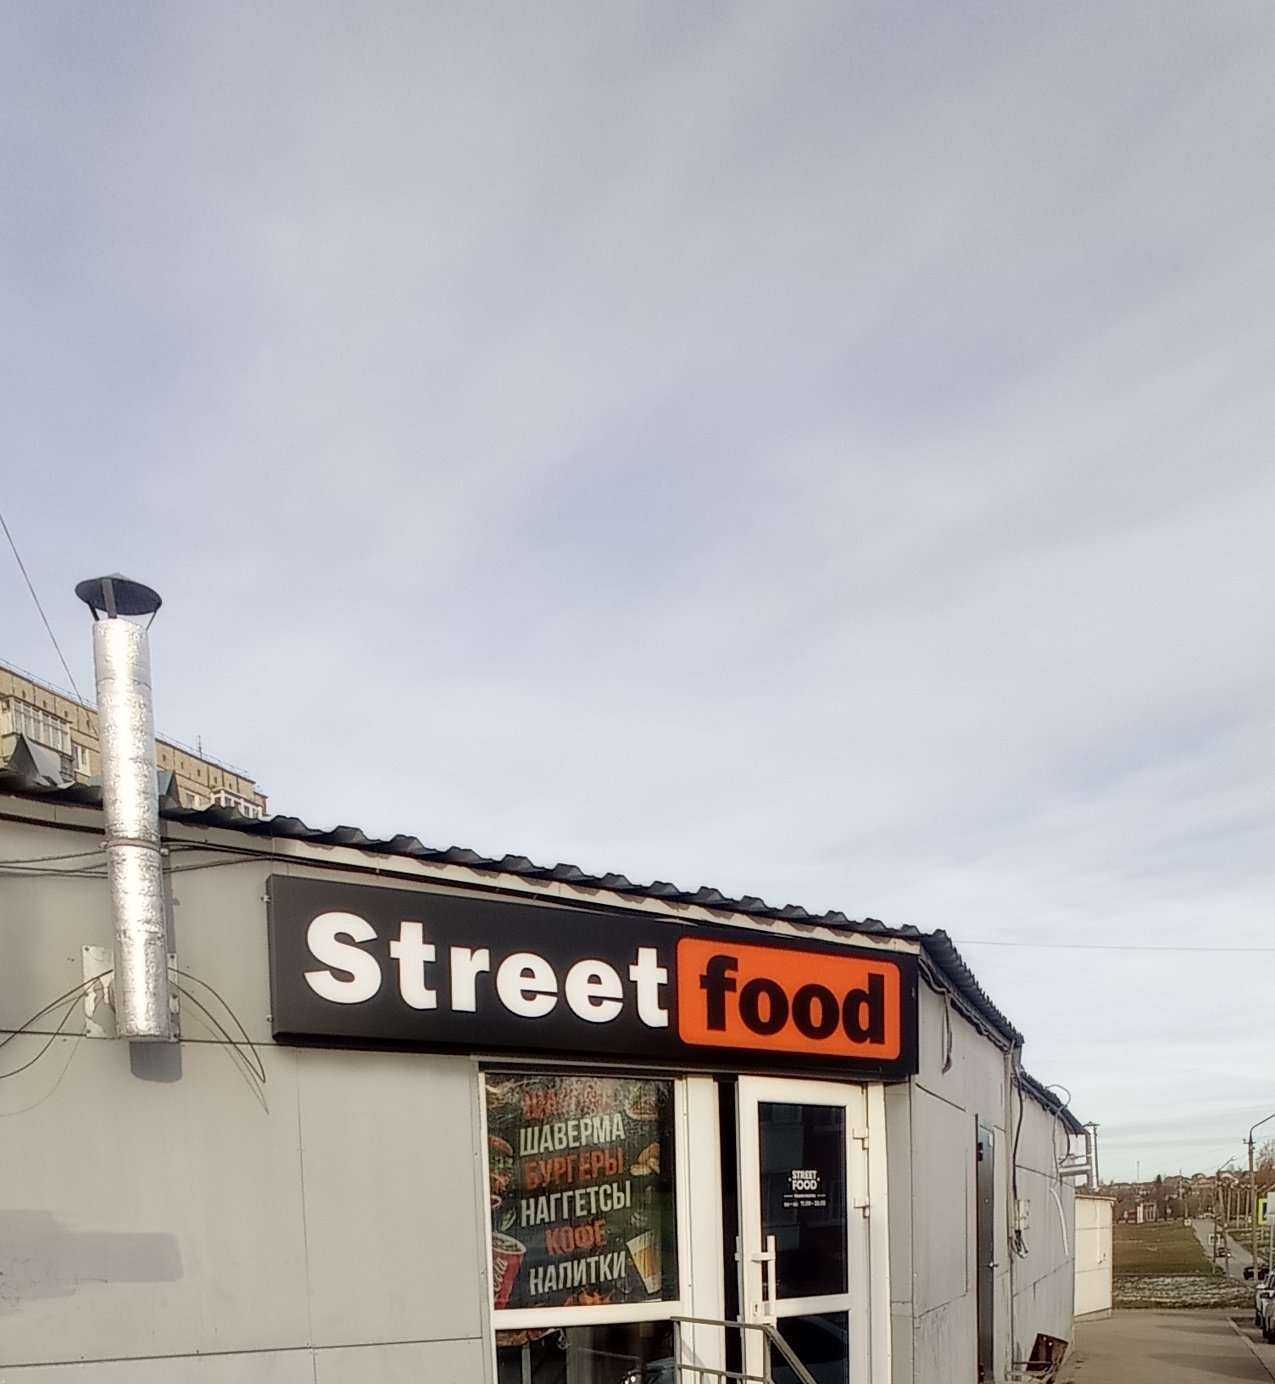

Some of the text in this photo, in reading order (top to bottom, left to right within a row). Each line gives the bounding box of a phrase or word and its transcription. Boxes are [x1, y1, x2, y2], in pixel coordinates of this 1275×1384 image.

[304, 911, 886, 1045] Street food
[519, 1112, 626, 1157] ШАВЕРМА
[523, 1149, 625, 1189] БУРГЕРЫ
[791, 1170, 818, 1180] STREET
[792, 1180, 818, 1191] FOOD
[520, 1180, 632, 1227] НАГГЕТСЫ
[545, 1220, 608, 1255] КОФЕ
[529, 1251, 627, 1296] НАПИТКИ
